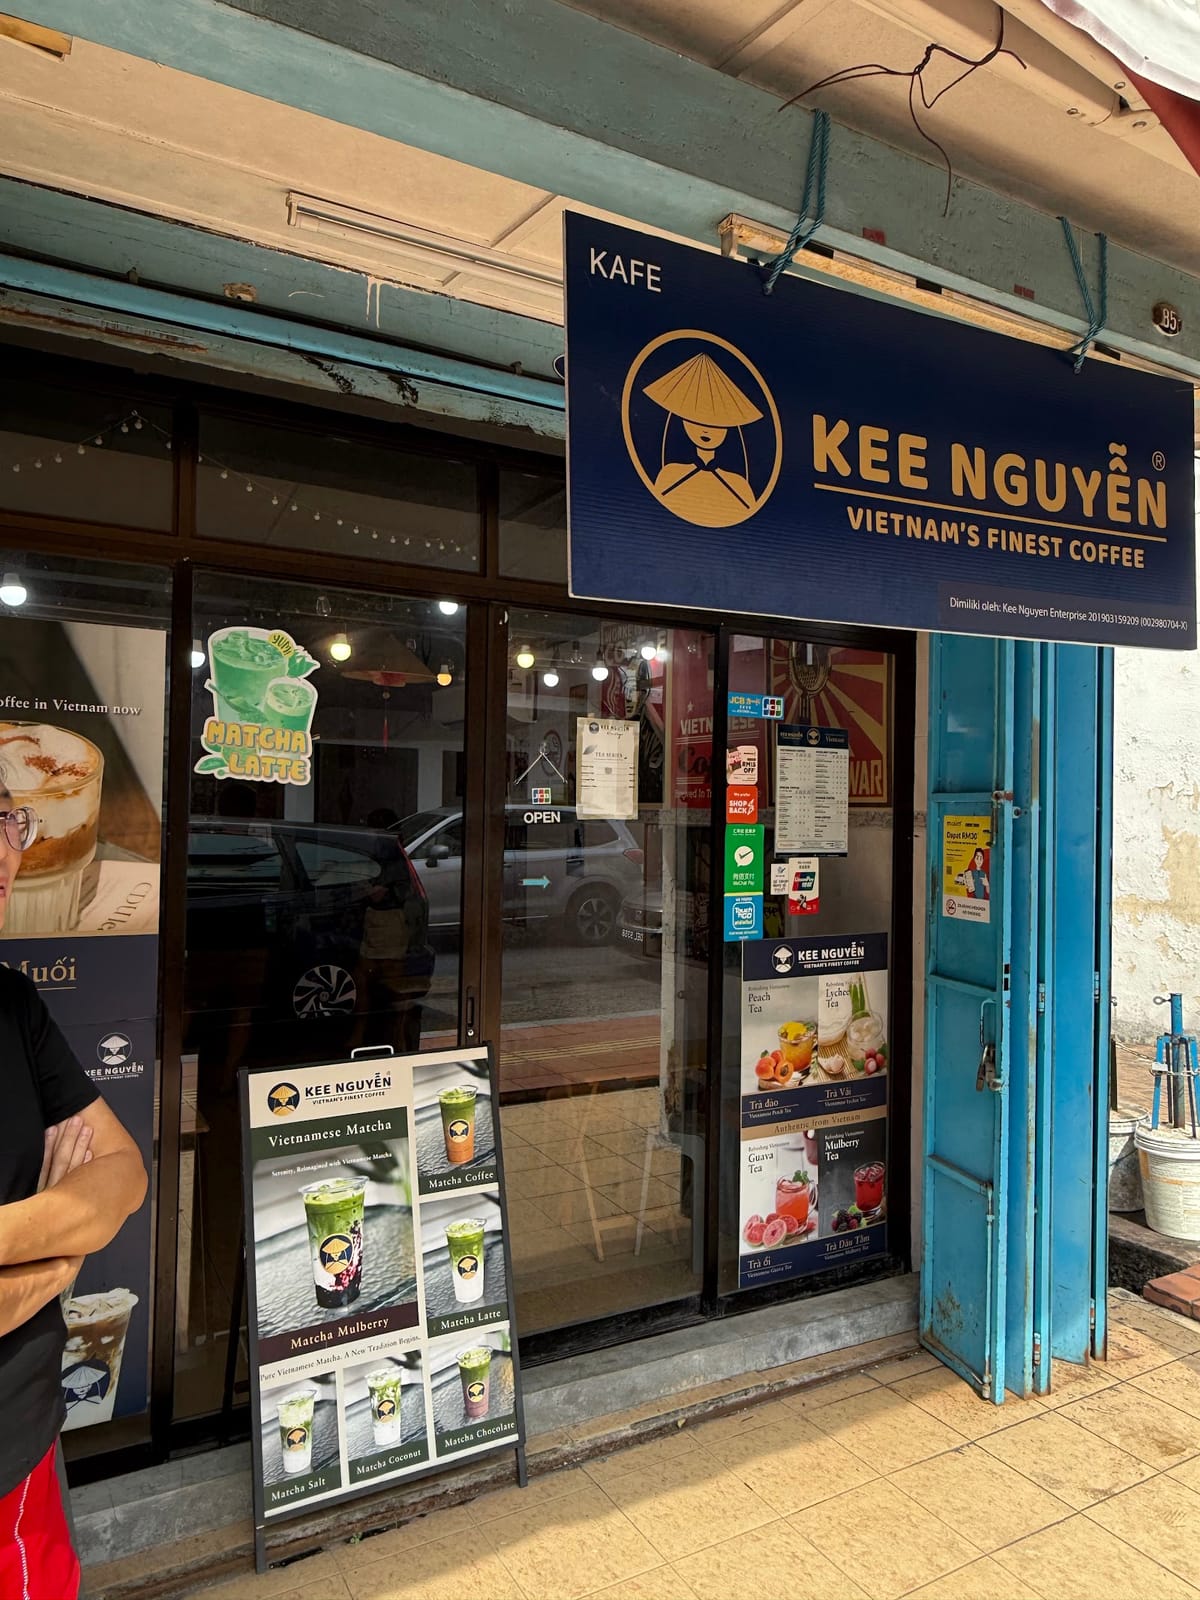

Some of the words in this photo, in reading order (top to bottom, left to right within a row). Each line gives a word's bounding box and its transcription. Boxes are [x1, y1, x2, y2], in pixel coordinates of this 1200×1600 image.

[590, 248, 662, 293] KAFE
[1163, 308, 1177, 330] 85
[813, 414, 928, 490] KEE
[952, 442, 1167, 529] NGUYỄN
[847, 506, 980, 547] VIETNAM'S
[987, 528, 1062, 558] FINEST
[1069, 540, 1145, 569] COFFEE
[950, 597, 980, 610] Dimiliki
[982, 602, 1002, 612] oleh:
[1002, 605, 1017, 614] Kee
[1018, 606, 1049, 618] Nguyen
[1050, 608, 1087, 622] Enterprise
[1088, 612, 1140, 626] 201903159209
[1140, 616, 1188, 630] (002980704-X)
[35, 698, 47, 709] in
[53, 699, 108, 712] Vietnam
[113, 705, 142, 715] now
[206, 720, 306, 754] MATCHA
[680, 716, 757, 737] VIETNESE
[228, 752, 306, 780] LATTE
[524, 812, 560, 824] OPEN
[798, 950, 818, 960] KEE
[748, 992, 770, 1002] Peach
[826, 1000, 839, 1008] Tea
[748, 1004, 762, 1014] Tea
[305, 1084, 331, 1097] KEE
[336, 1072, 391, 1093] NGUYỄN
[269, 1129, 341, 1147] Vietnamese
[346, 1120, 392, 1136] Matcha
[774, 1121, 809, 1134] Authentic
[812, 1118, 829, 1127] from
[831, 1114, 861, 1123] Vietnam
[825, 1138, 859, 1151] Mulberry
[748, 1152, 773, 1162] Guava
[825, 1152, 839, 1161] Tea
[749, 1164, 762, 1174] Tea
[428, 1176, 462, 1189] Matcha
[465, 1171, 494, 1183] Coffee
[441, 1316, 475, 1330] Matcha
[478, 1310, 501, 1322] Latte
[291, 1332, 333, 1350] Matcha
[338, 1318, 389, 1338] Mulberry
[260, 1372, 276, 1382] Pure
[277, 1361, 314, 1376] Vietnamese
[316, 1354, 342, 1366] Matcha.
[344, 1351, 350, 1359] A
[351, 1348, 366, 1357] New
[368, 1340, 398, 1353] Tradition
[444, 1434, 474, 1448] Matcha
[476, 1421, 515, 1438] Chocolate
[356, 1460, 386, 1475] Matcha
[388, 1450, 422, 1465] Coconut
[271, 1484, 305, 1502] Matcha
[308, 1476, 326, 1490] Salt
